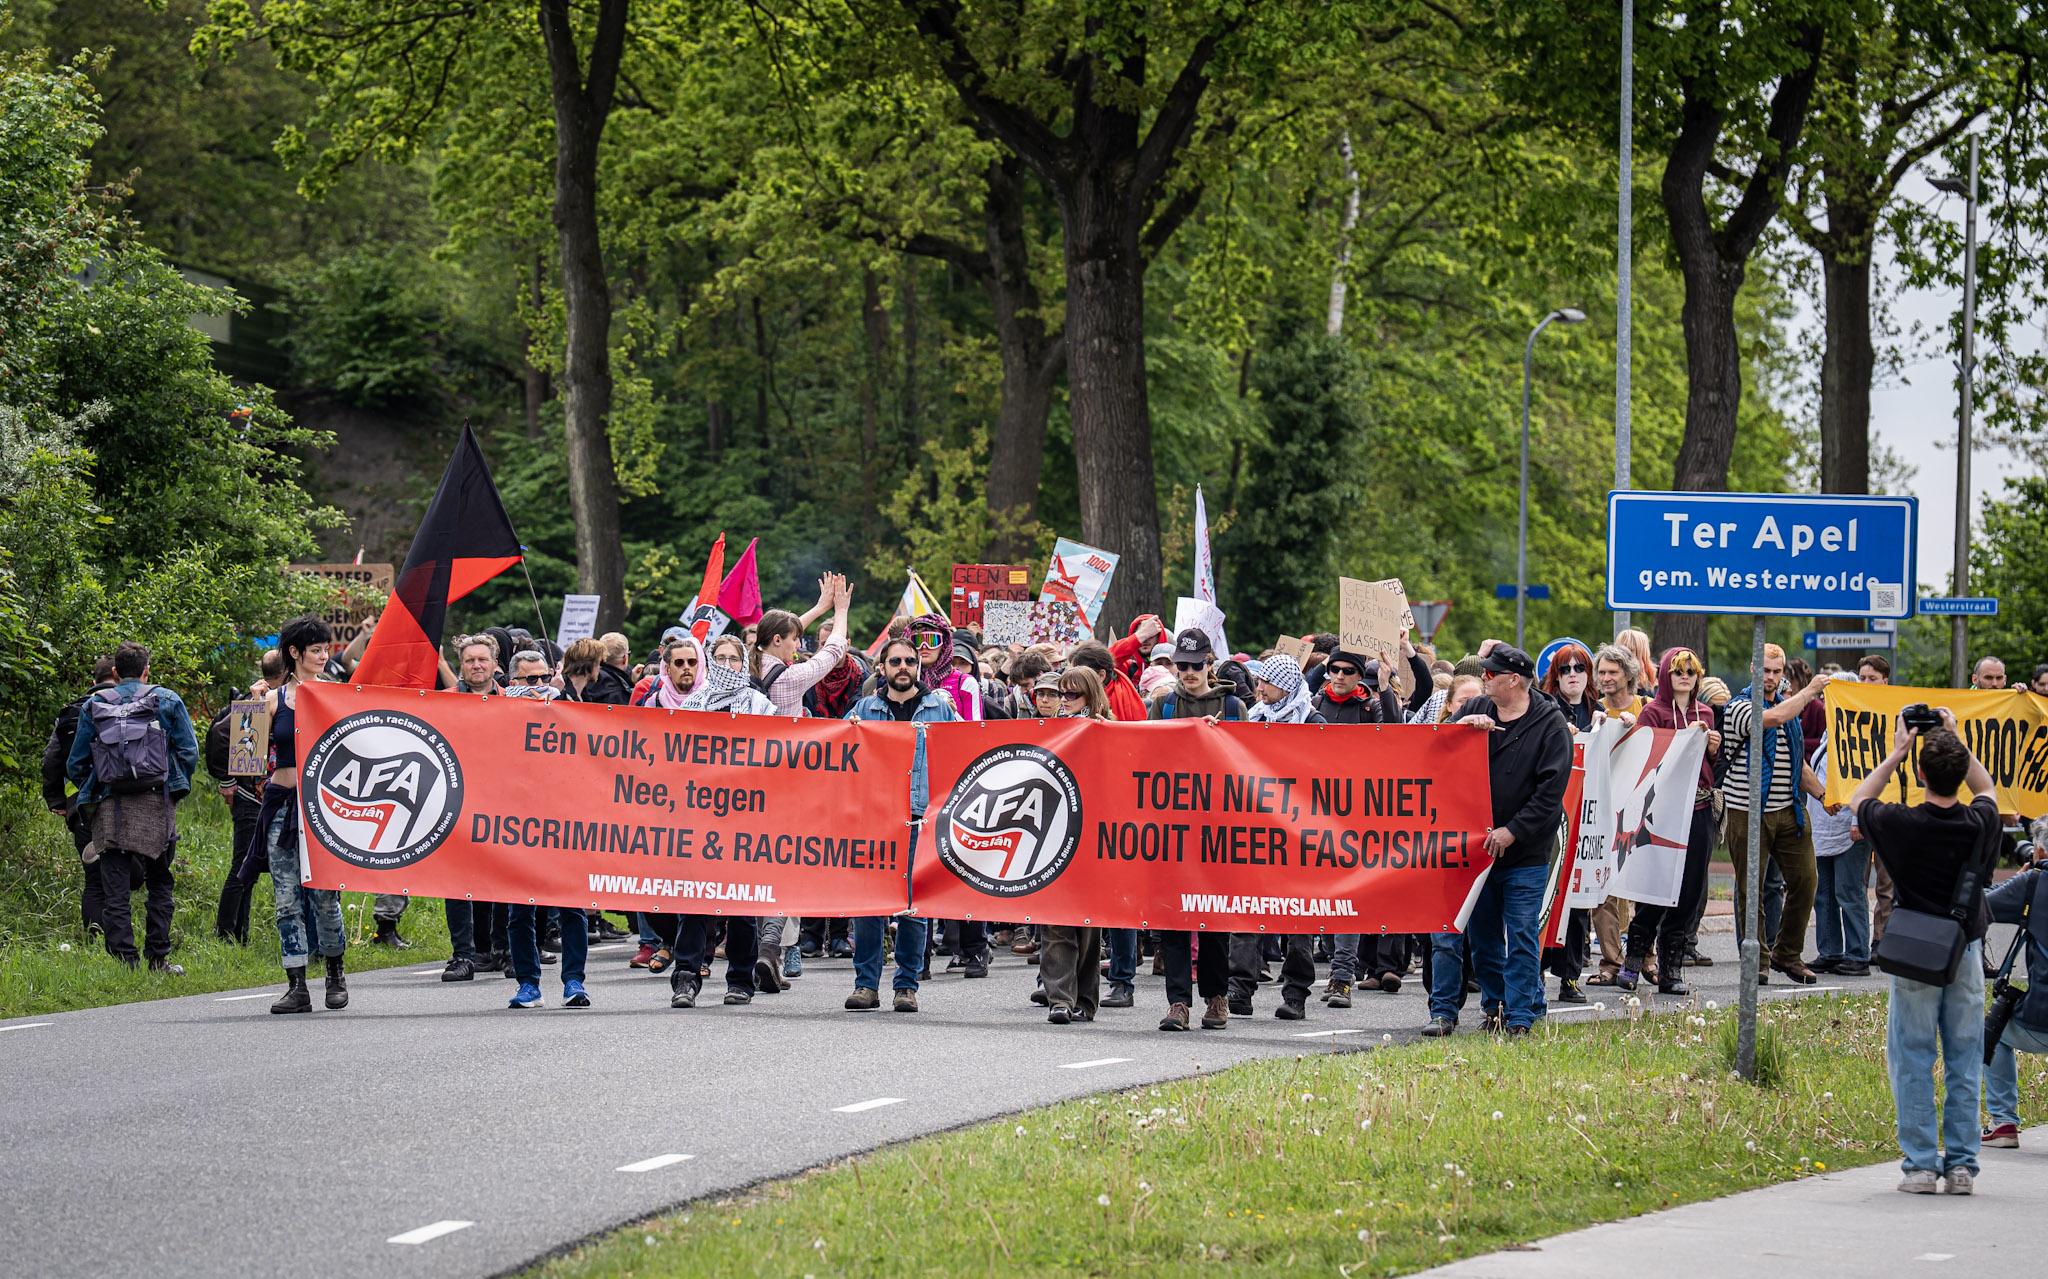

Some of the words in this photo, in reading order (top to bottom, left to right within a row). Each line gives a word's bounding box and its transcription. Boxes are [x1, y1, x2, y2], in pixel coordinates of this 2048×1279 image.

[1663, 512, 1737, 548] Ter
[1752, 515, 1858, 558] Apel
[954, 567, 1000, 585] GEEN
[1086, 555, 1112, 573] 1000
[1639, 568, 1699, 592] gem.
[983, 588, 1029, 601] MENS
[1344, 581, 1378, 602] GEEN
[1925, 602, 1990, 612] Westerstraat
[1345, 614, 1375, 633] MAAR
[1831, 637, 1871, 645] Centrum
[306, 755, 322, 778] Stop
[319, 714, 384, 753] discriminatie,
[386, 715, 428, 737] racisme
[428, 734, 438, 744] &
[436, 742, 459, 789] fascisme
[524, 722, 577, 755] Eén
[587, 729, 655, 767] volk,
[663, 732, 861, 773] WERELDVOLK
[1835, 706, 1892, 784] GEEN
[230, 757, 263, 773] LEVEN
[329, 758, 421, 805] AFA
[942, 793, 959, 815] Stop
[957, 750, 1014, 794] discriminatie,
[1016, 749, 1048, 762] racisme
[1047, 759, 1056, 769] &
[1055, 767, 1078, 813] fascisme
[331, 800, 385, 821] Fryslân
[613, 774, 675, 813] Nee,
[685, 780, 766, 817] tegen
[959, 787, 1044, 831] AFA
[1132, 771, 1212, 811] TOEN
[1223, 774, 1299, 823] NIET,
[1311, 777, 1353, 817] NU
[1364, 778, 1437, 825] NIET,
[307, 801, 364, 862] afa.fryslan@gmail.com
[370, 856, 400, 865] Postbus
[402, 852, 411, 861] 10
[415, 841, 432, 855] 9050
[430, 832, 441, 845] AA
[438, 811, 453, 834] Stiens
[471, 813, 694, 858] DISCRIMINATIE
[702, 830, 724, 861] &
[733, 832, 897, 870] RACISME!!!
[959, 832, 1013, 849] Fryslân
[1097, 821, 1190, 862] NOOIT
[1201, 825, 1289, 866] MEER
[1300, 829, 1470, 869] FASCISME!
[1000, 884, 1028, 893] Postbus
[1029, 879, 1038, 888] 10
[1040, 866, 1057, 881] 9050
[1054, 858, 1065, 870] AA
[1061, 836, 1075, 859] Stiens
[588, 873, 776, 903] WWW.AFAFRYSLAN.NL
[1181, 893, 1358, 917] WWW.AFAFRYSLAN.NL
